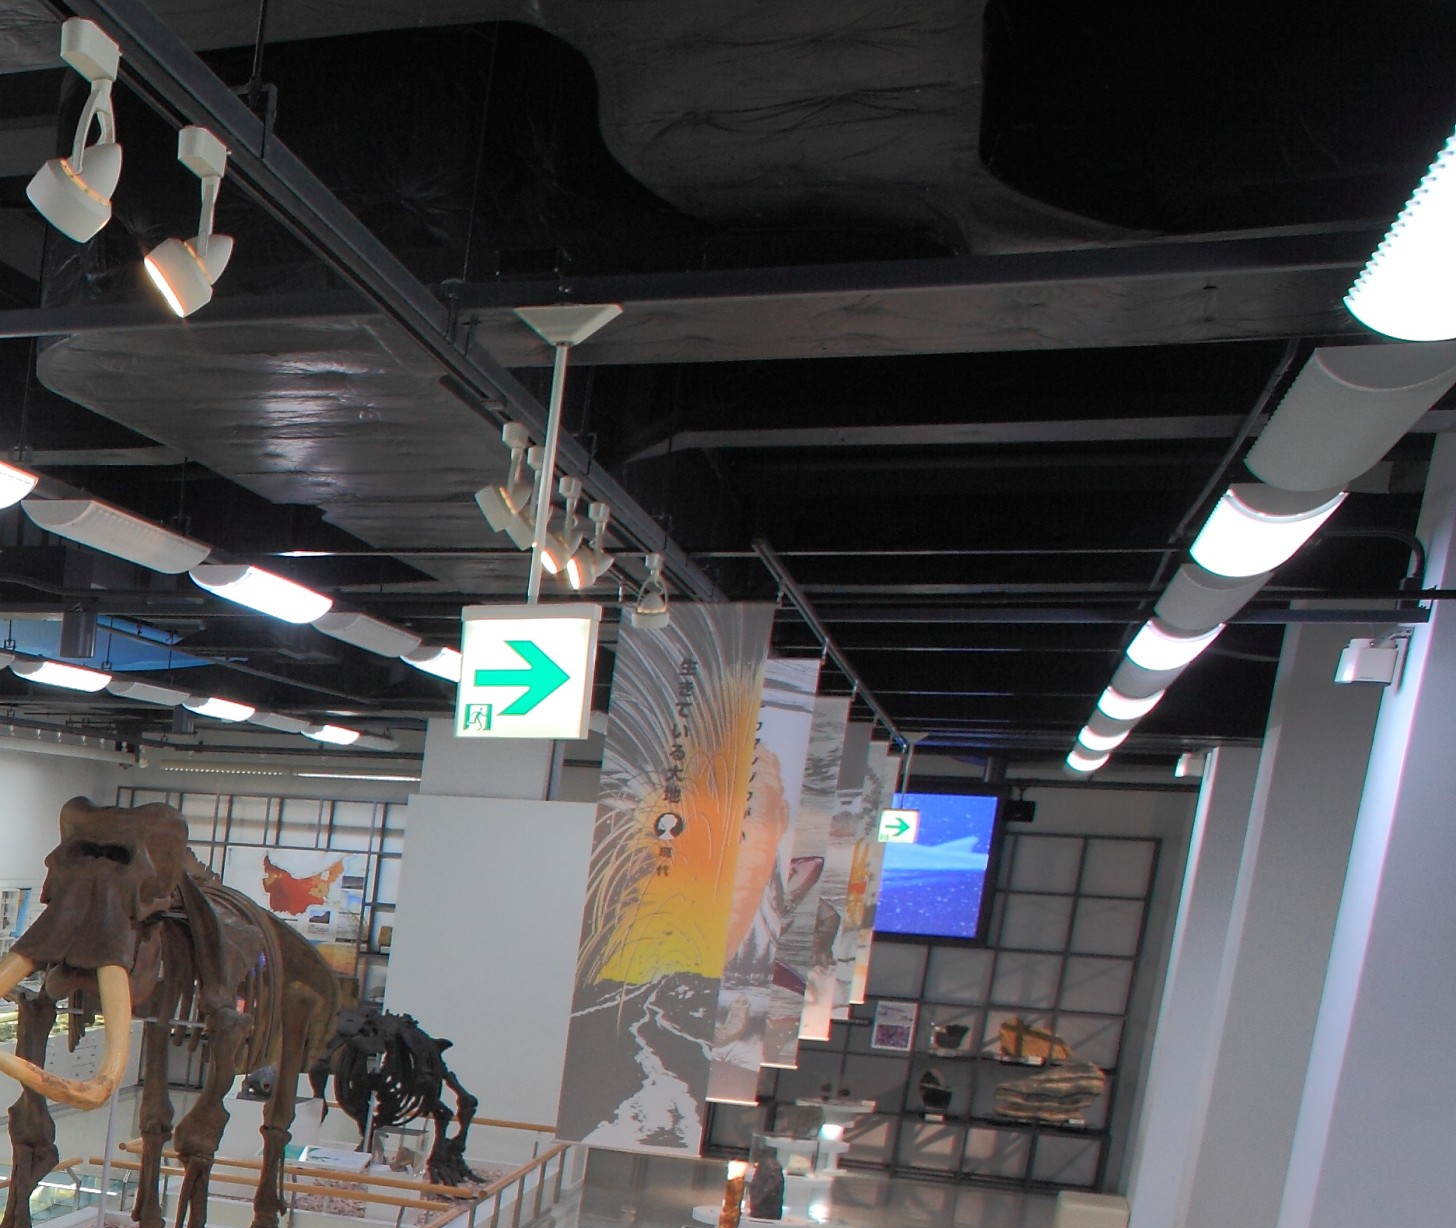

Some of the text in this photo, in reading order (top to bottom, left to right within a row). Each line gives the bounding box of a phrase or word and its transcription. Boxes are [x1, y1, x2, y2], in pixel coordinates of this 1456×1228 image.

[663, 657, 699, 804] 生きている大地
